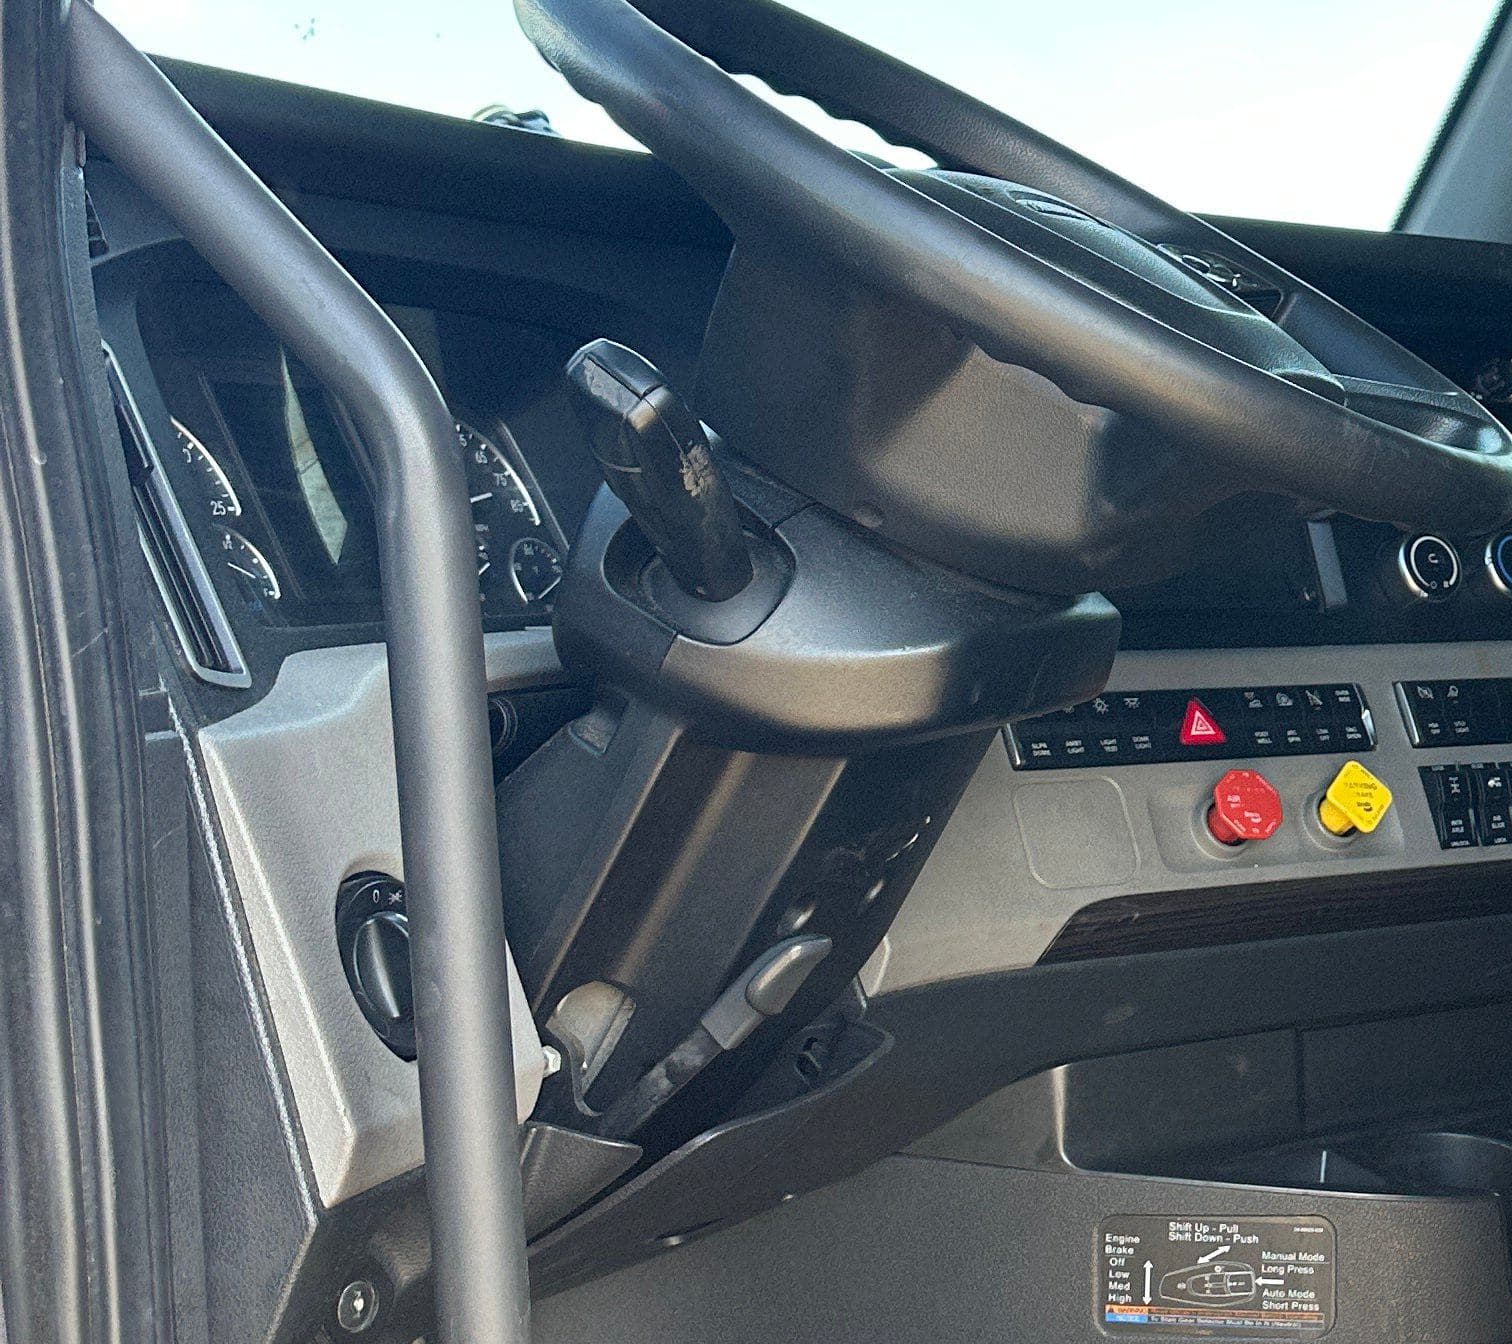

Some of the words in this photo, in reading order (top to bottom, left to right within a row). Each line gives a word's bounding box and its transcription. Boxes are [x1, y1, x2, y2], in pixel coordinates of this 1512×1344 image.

[492, 472, 507, 487] 75
[210, 500, 226, 516] 25
[1168, 1221, 1192, 1232] Shift
[1194, 1223, 1209, 1233] Up
[1219, 1223, 1239, 1233] Pull
[1105, 1233, 1140, 1245] Engine
[1168, 1232, 1192, 1241] Shift
[1194, 1232, 1223, 1243] Down
[1233, 1234, 1259, 1244] Push
[1105, 1244, 1134, 1255] Brake
[1109, 1257, 1126, 1266] Off
[1261, 1251, 1296, 1261] Manual
[1298, 1252, 1325, 1262] Mode
[1108, 1269, 1130, 1279] Low
[1261, 1264, 1285, 1275] Long
[1287, 1264, 1314, 1274] Press
[1108, 1281, 1131, 1291] Med
[1108, 1294, 1132, 1304] High
[1262, 1288, 1285, 1298] Auto
[1288, 1289, 1315, 1299] Mode
[1262, 1301, 1288, 1310] Short
[1291, 1301, 1320, 1311] Press
